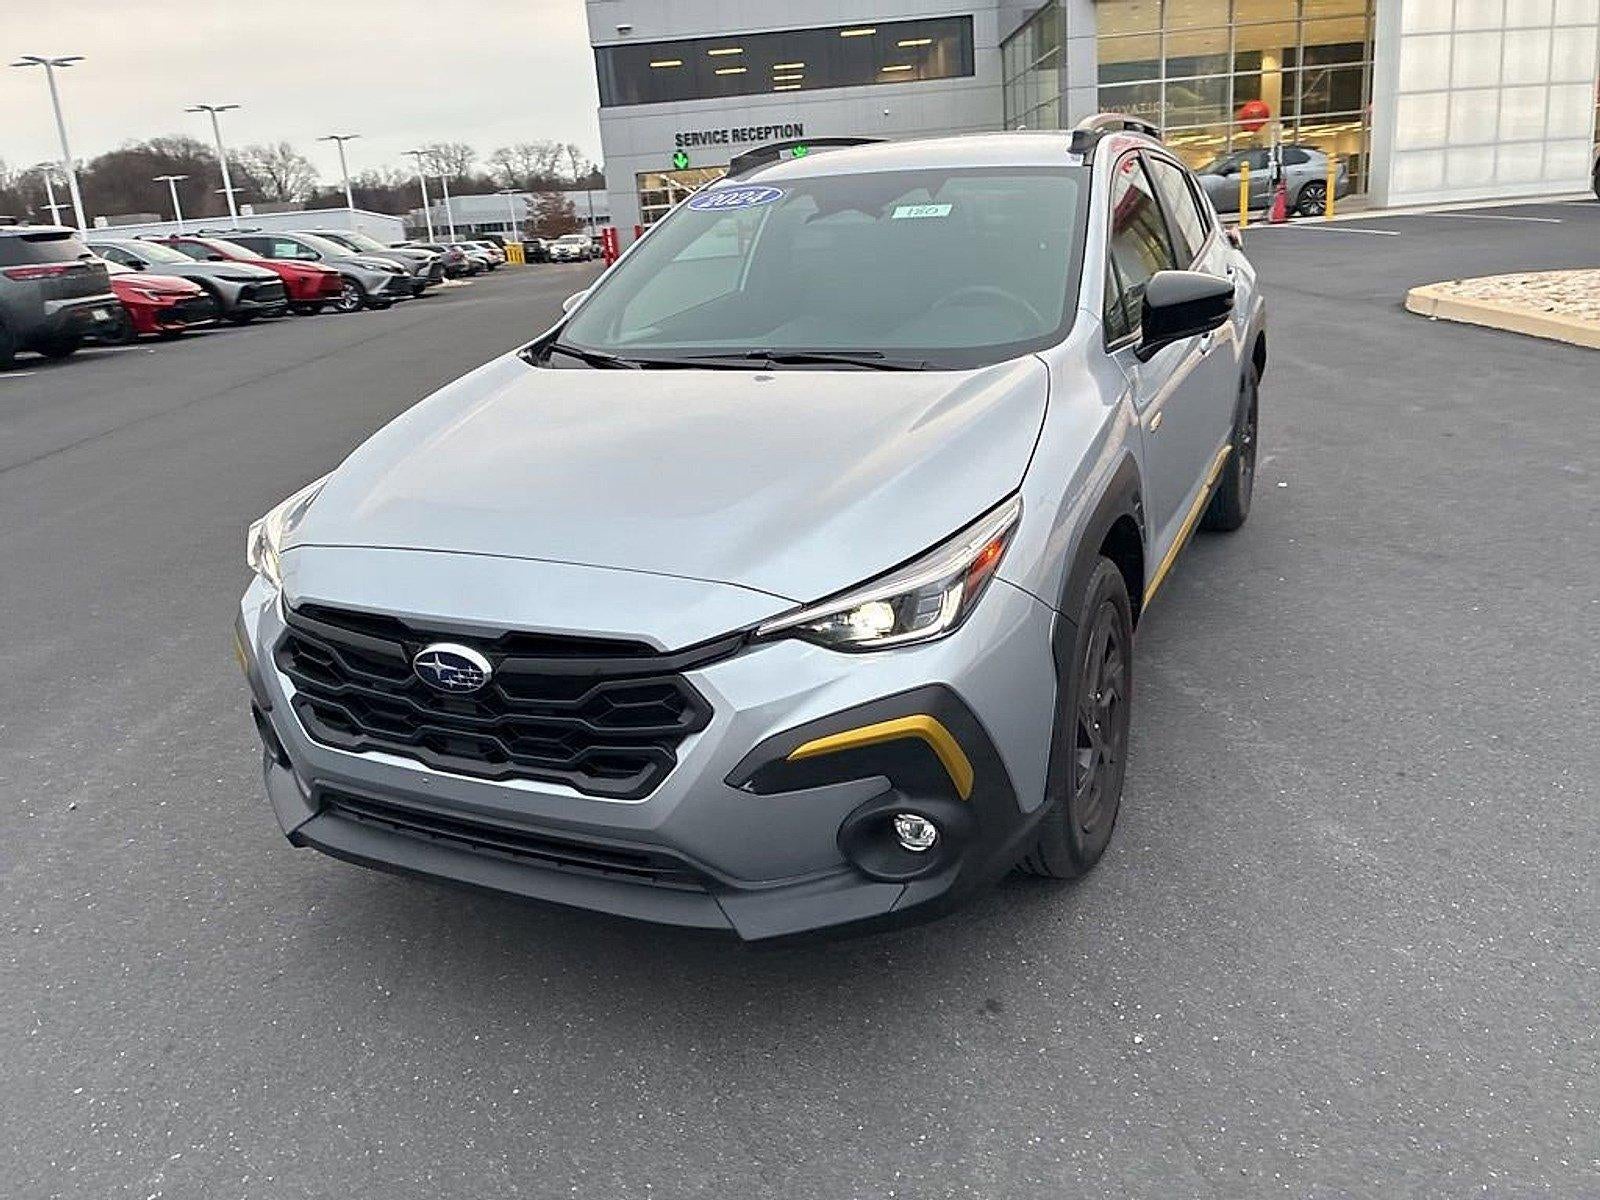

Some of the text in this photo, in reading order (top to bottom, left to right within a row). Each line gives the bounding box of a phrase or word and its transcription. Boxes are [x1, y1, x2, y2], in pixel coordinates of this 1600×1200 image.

[675, 123, 803, 147] SERVICE RECEPTION
[700, 188, 770, 208] 2024
